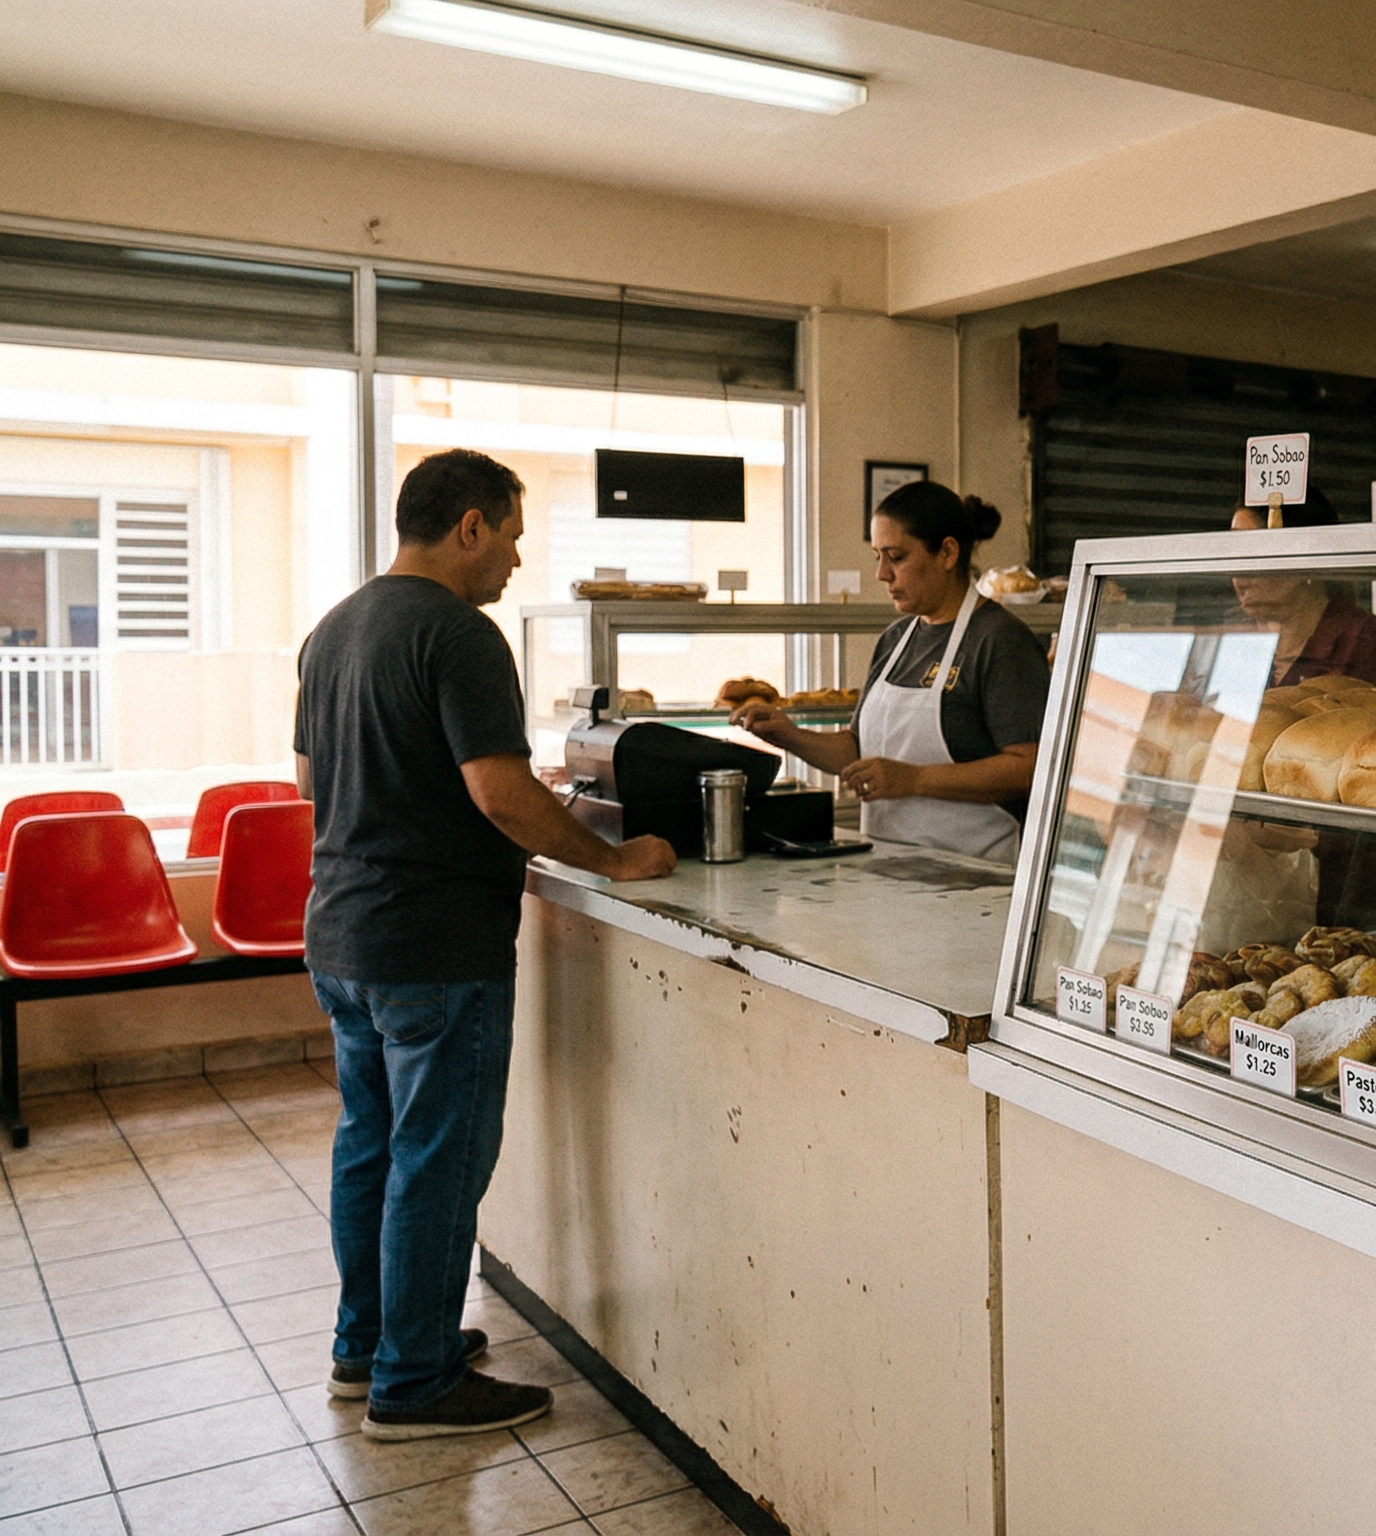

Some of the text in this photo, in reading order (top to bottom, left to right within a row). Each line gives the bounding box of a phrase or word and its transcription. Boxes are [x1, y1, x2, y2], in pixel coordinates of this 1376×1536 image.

[1250, 443, 1305, 465] Pan Sobao
[1260, 470, 1291, 488] $1.50
[1060, 976, 1075, 992] Pan
[1119, 994, 1137, 1011] Pan
[1235, 1029, 1290, 1060] Mallorcas
[1246, 1053, 1277, 1077] $1.25
